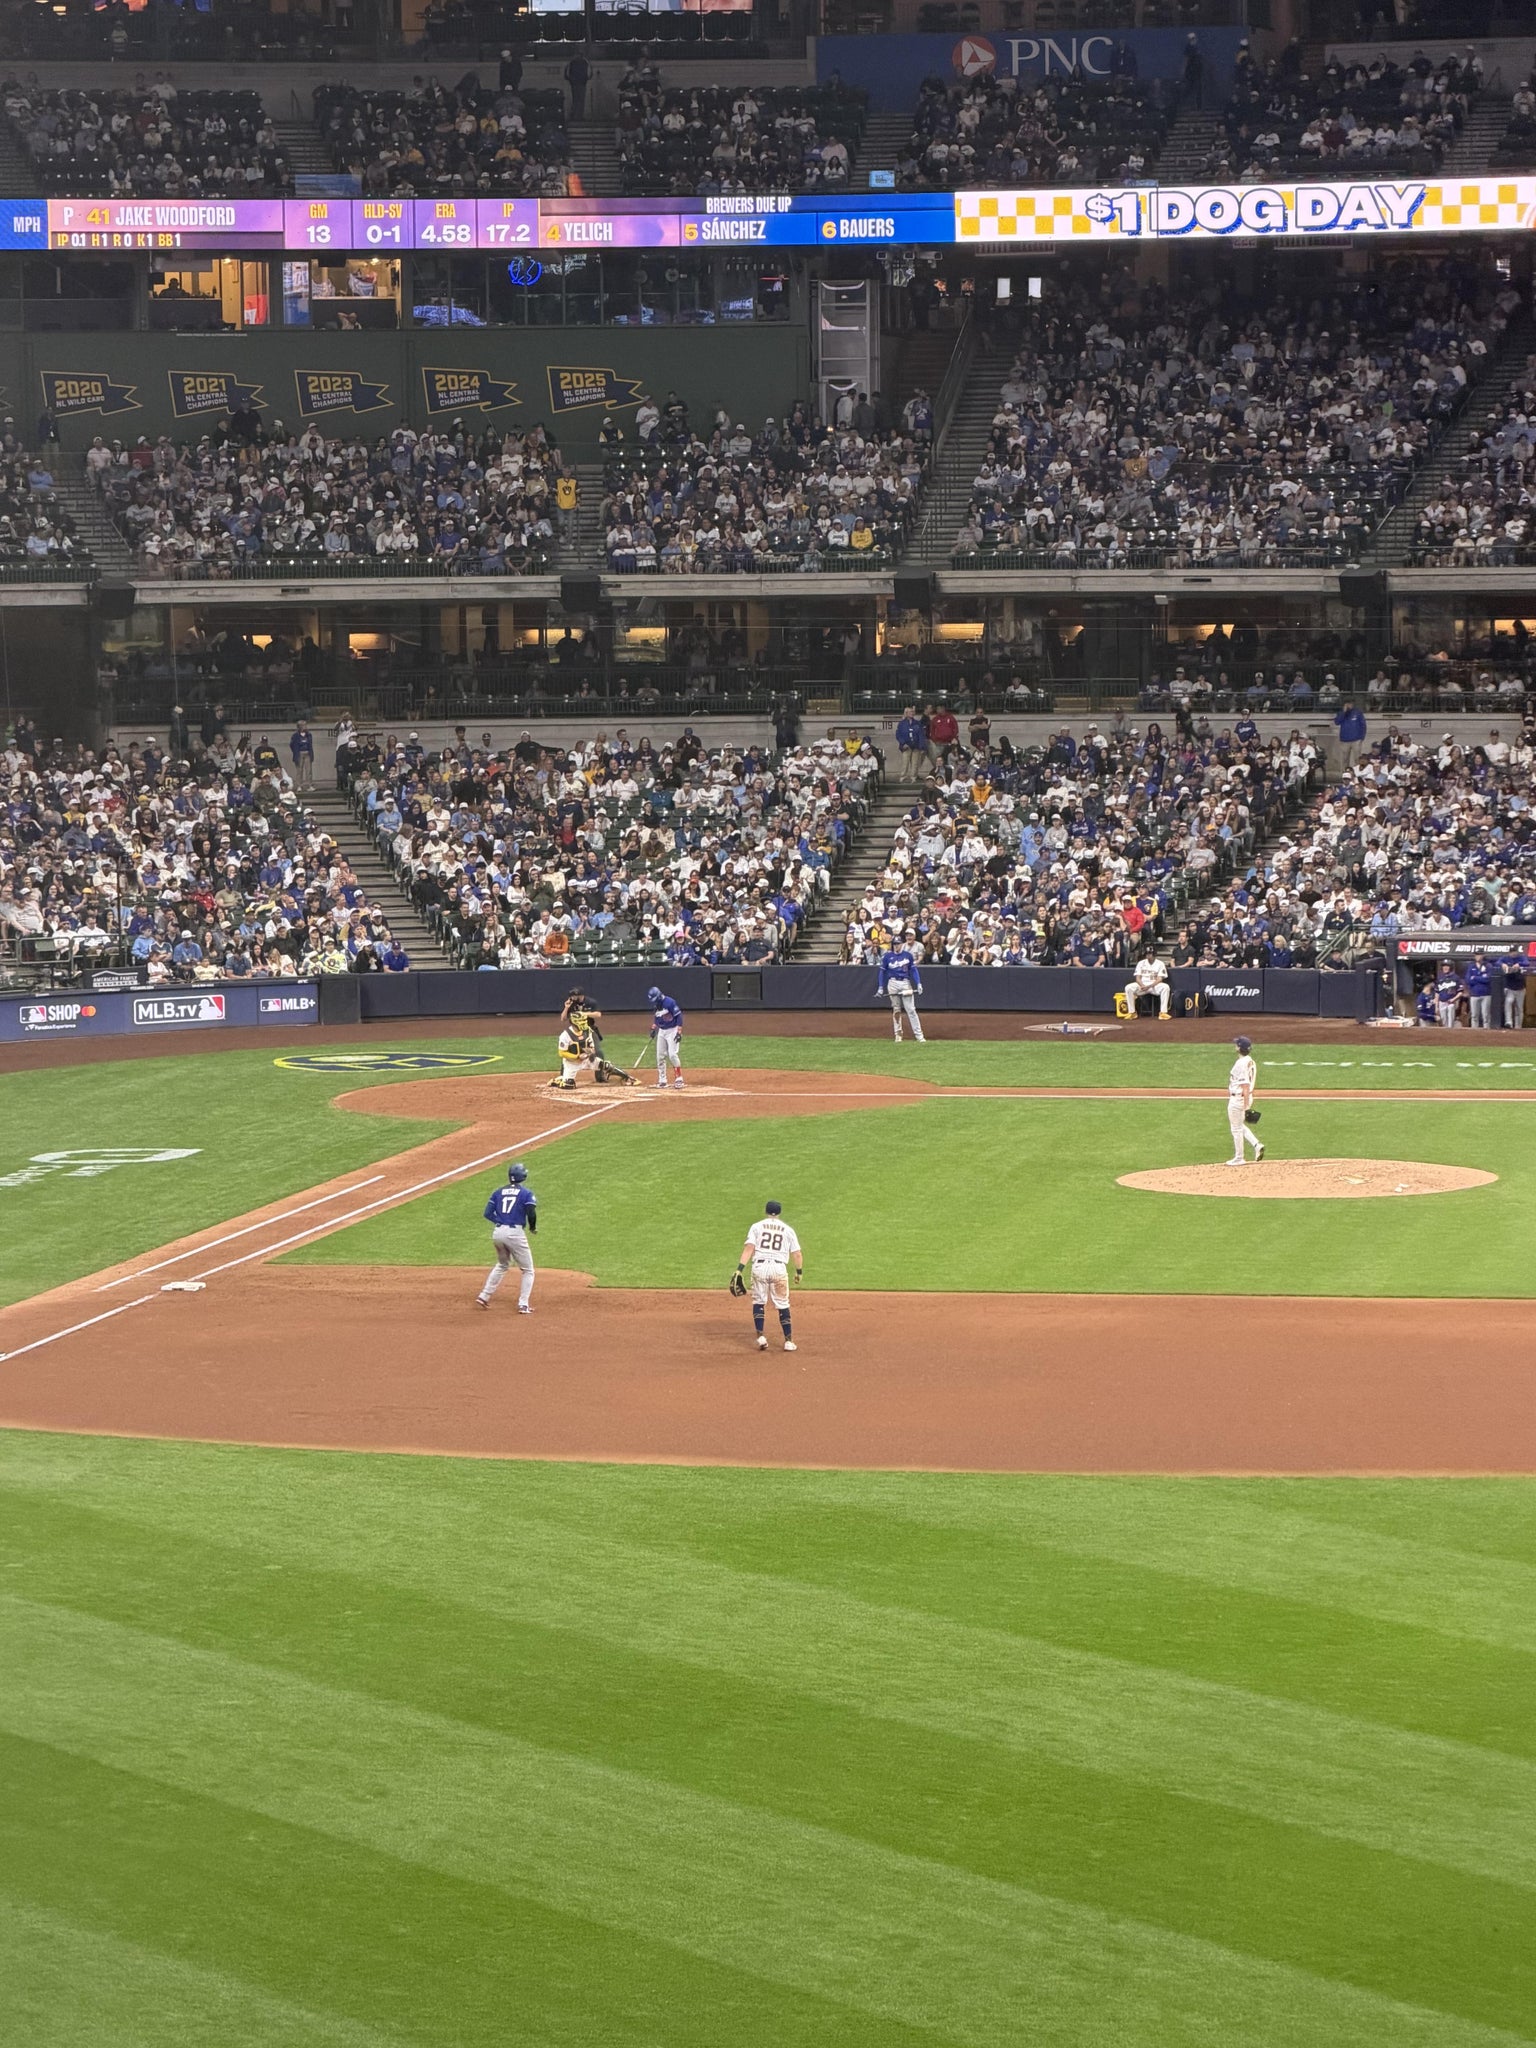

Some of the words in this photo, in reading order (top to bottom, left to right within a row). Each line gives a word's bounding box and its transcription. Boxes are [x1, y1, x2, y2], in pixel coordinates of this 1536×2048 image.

[1005, 36, 1113, 76] PNC
[309, 203, 328, 219] GM
[364, 203, 403, 219] HLD-SV
[435, 203, 456, 219] ERA
[503, 203, 515, 218] IP
[706, 198, 753, 214] BREWERS
[755, 197, 776, 213] DUE
[777, 197, 792, 212] UP
[1085, 192, 1141, 236] $1
[1149, 188, 1287, 235] DOG
[1295, 184, 1427, 232] DAY
[13, 216, 41, 233] MPH
[63, 206, 73, 225] P
[86, 208, 110, 225] 41
[115, 207, 152, 226] JAKE
[155, 206, 236, 226] WOODFORD
[306, 225, 331, 243] 13
[366, 225, 401, 243] 0-1
[421, 224, 471, 243] 4.58
[486, 224, 530, 242] 17.2
[546, 225, 560, 242] 4
[563, 222, 613, 242] YELICH
[684, 225, 698, 241] 5
[702, 217, 766, 240] SÁNCHEZ
[822, 222, 837, 238] 6
[840, 219, 894, 238] BAUERS
[57, 234, 69, 246] IP
[71, 233, 86, 246] 0.1
[91, 234, 100, 246] H
[101, 234, 108, 246] 1
[113, 234, 122, 246] R
[124, 233, 132, 246] 0
[137, 234, 146, 246] K
[146, 233, 153, 246] 1
[158, 234, 173, 246] BB
[175, 233, 181, 246] 1
[55, 380, 102, 399] 2020
[183, 376, 227, 394] 2021
[307, 375, 353, 393] 2023
[434, 374, 480, 391] 2024
[560, 372, 606, 390] 2025
[185, 395, 196, 403] NL
[197, 392, 228, 401] CENTRAL
[322, 391, 352, 400] CENTRAL
[449, 389, 480, 398] CENTRAL
[564, 393, 606, 405] CHAMPIONS
[574, 387, 606, 395] CENTRAL
[56, 400, 67, 408] NL
[67, 398, 85, 406] WILD
[187, 398, 228, 410] CHAMPIONS
[312, 396, 352, 408] CHAMPIONS
[439, 395, 480, 406] CHAMPIONS
[1407, 941, 1451, 953] KUNES
[1204, 985, 1234, 996] KWIK
[1235, 985, 1260, 997] TRIP
[282, 997, 316, 1010] MLB+
[48, 1004, 81, 1021] SHOP
[502, 1196, 516, 1213] 17
[760, 1232, 783, 1251] 28
